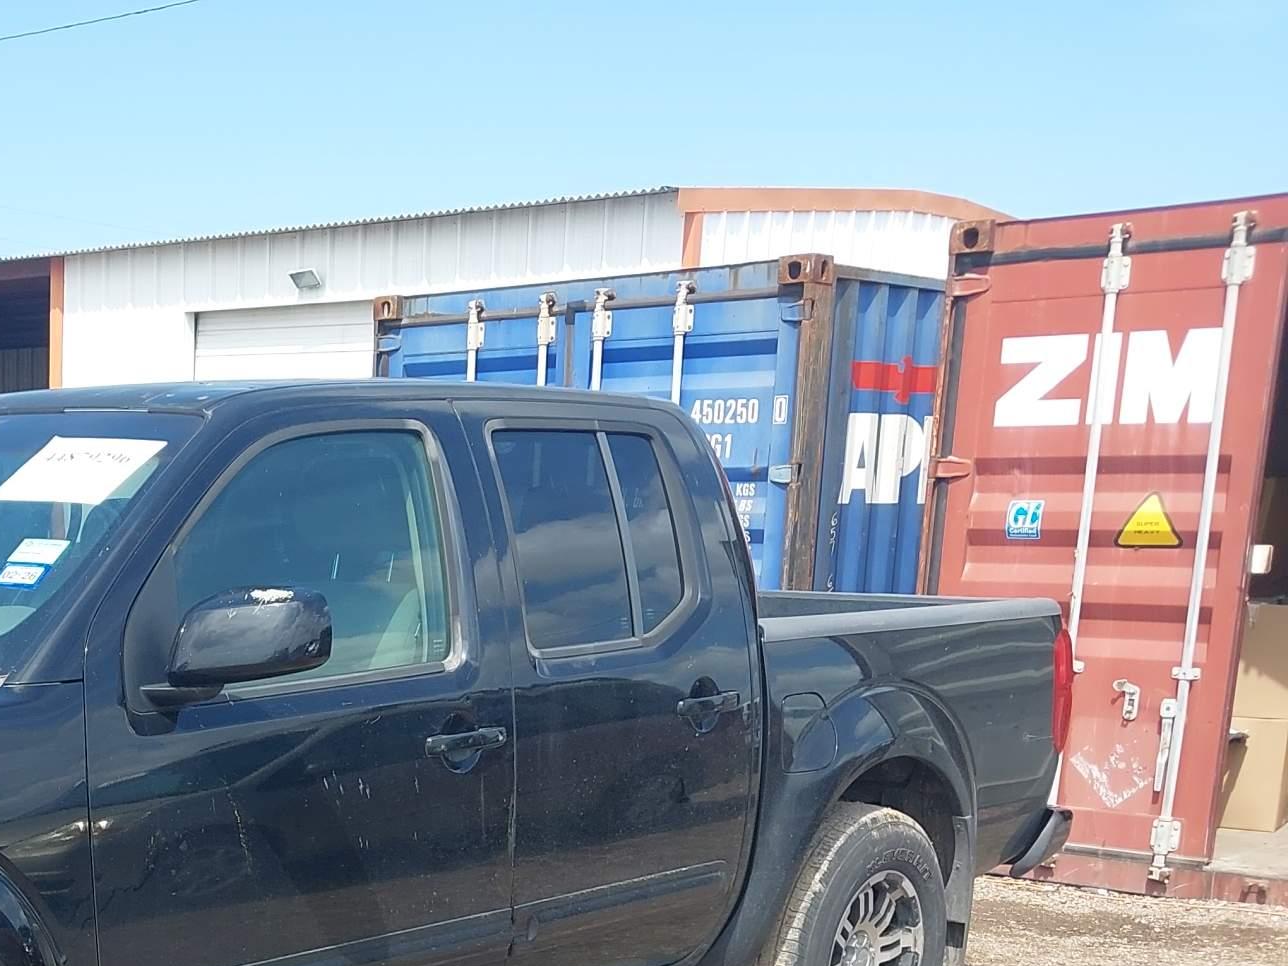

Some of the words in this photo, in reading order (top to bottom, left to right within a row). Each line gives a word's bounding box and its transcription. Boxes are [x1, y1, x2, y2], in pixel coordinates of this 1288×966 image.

[993, 327, 1224, 428] ZIM
[691, 399, 759, 424] 450250
[735, 482, 755, 497] KGS
